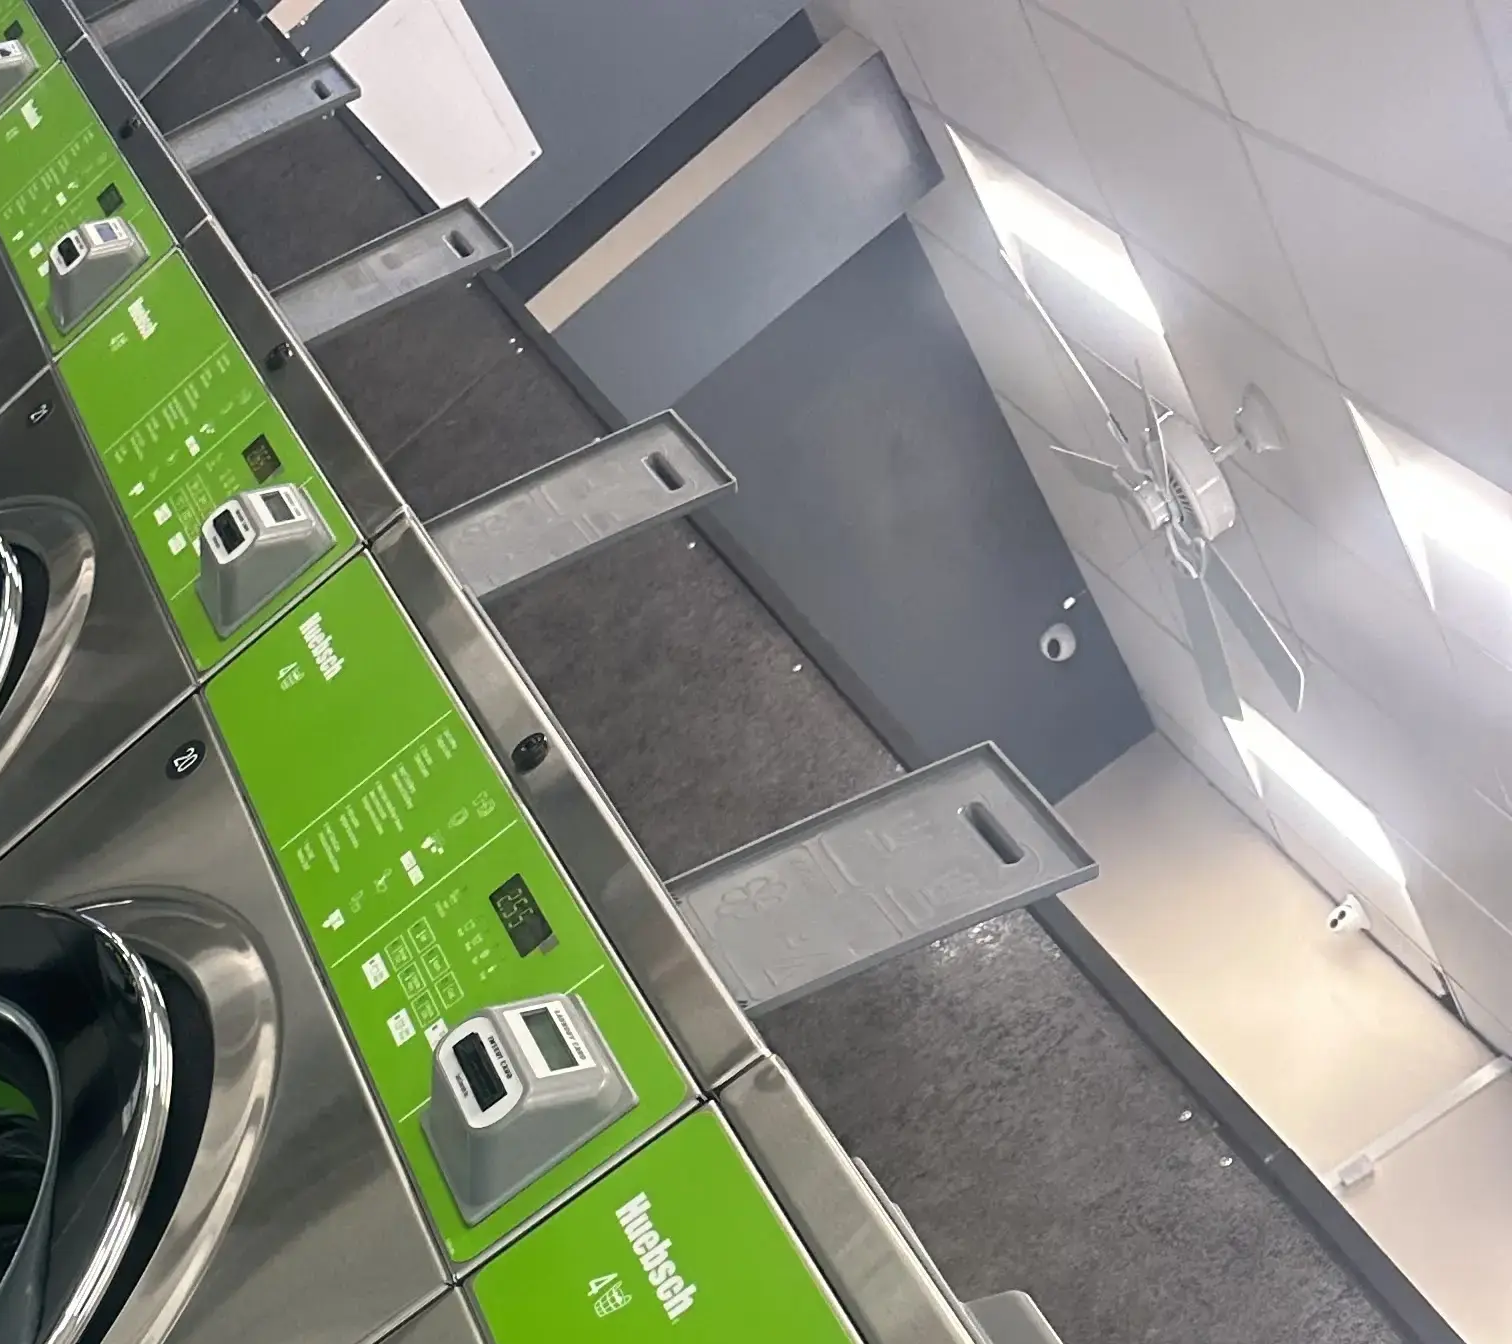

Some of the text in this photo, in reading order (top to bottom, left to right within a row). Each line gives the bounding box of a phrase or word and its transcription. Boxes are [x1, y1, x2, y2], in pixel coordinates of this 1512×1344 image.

[299, 612, 344, 680] Huebsch
[174, 748, 198, 772] 20
[616, 1192, 696, 1320] Huebsch
[588, 1273, 620, 1296] 4
